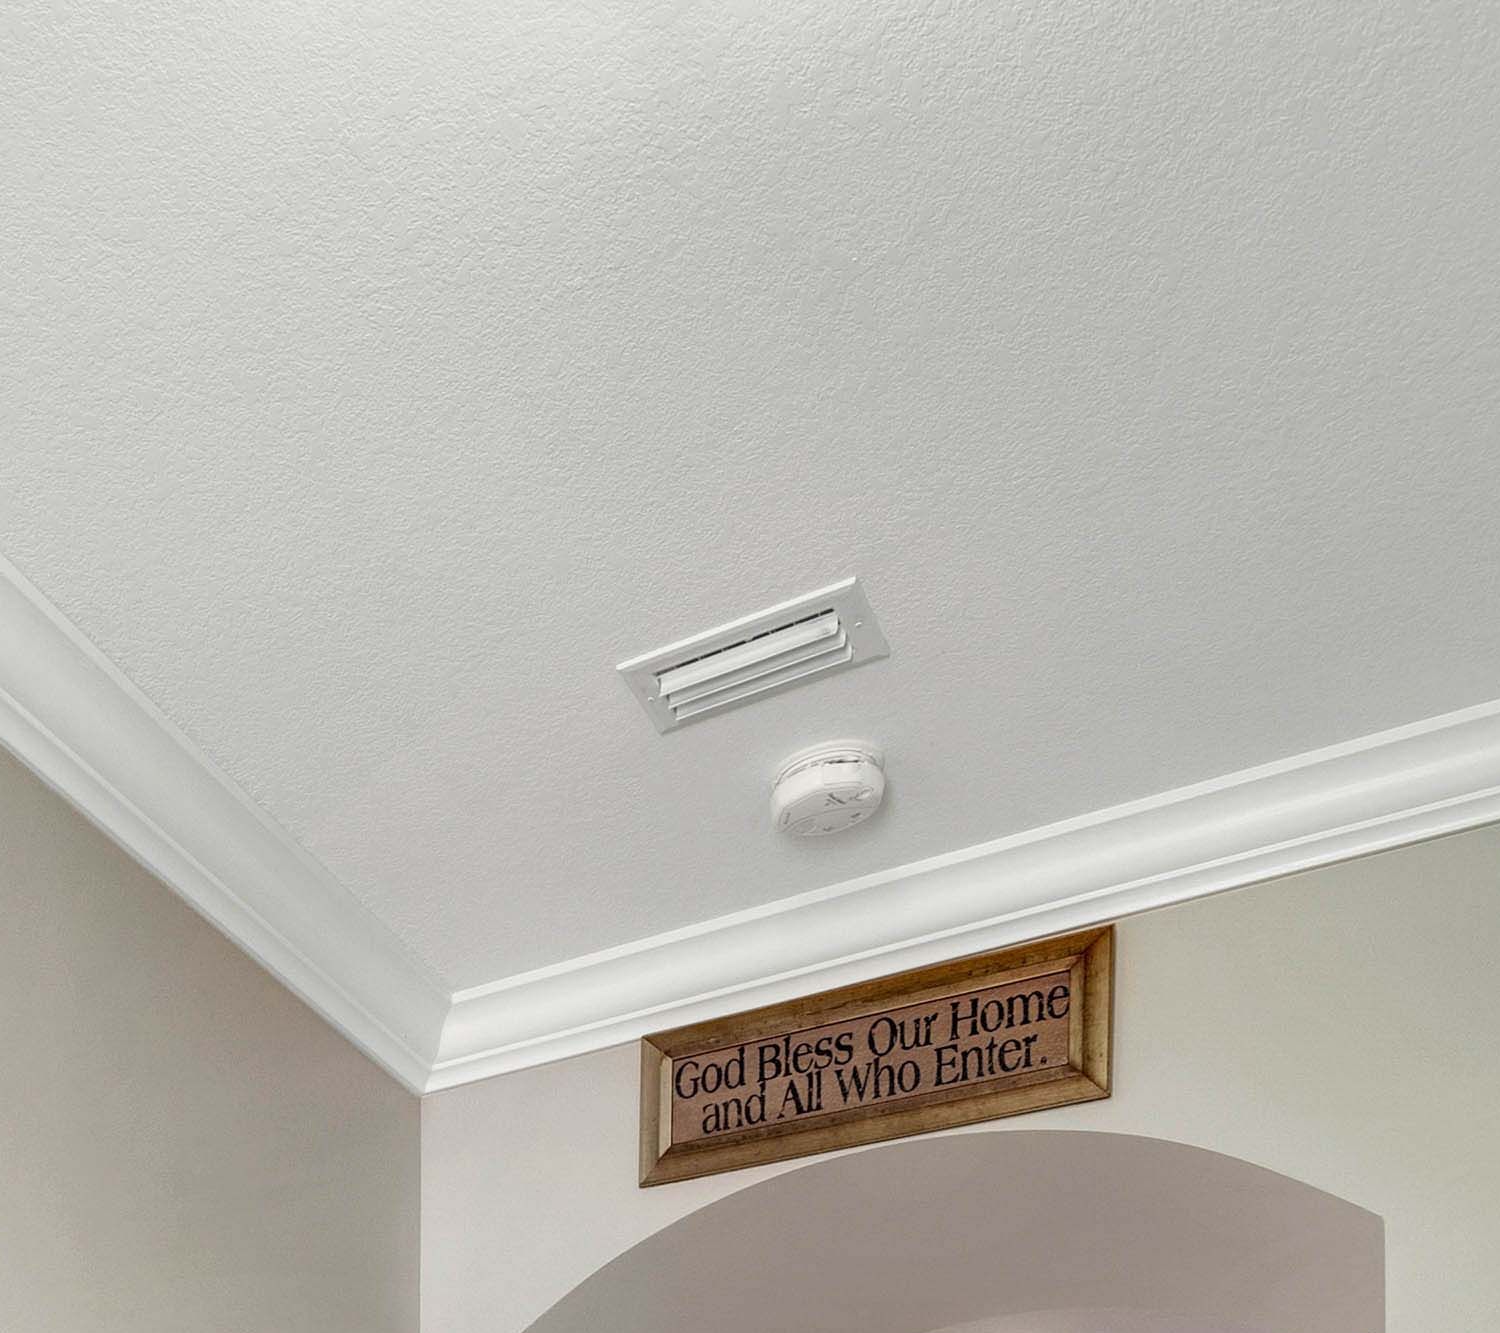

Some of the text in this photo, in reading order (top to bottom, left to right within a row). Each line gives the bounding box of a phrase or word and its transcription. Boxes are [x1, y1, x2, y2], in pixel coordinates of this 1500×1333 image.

[675, 984, 1071, 1099] God Bless Our Home
[702, 1033, 1048, 1134] and All Who Enter.
